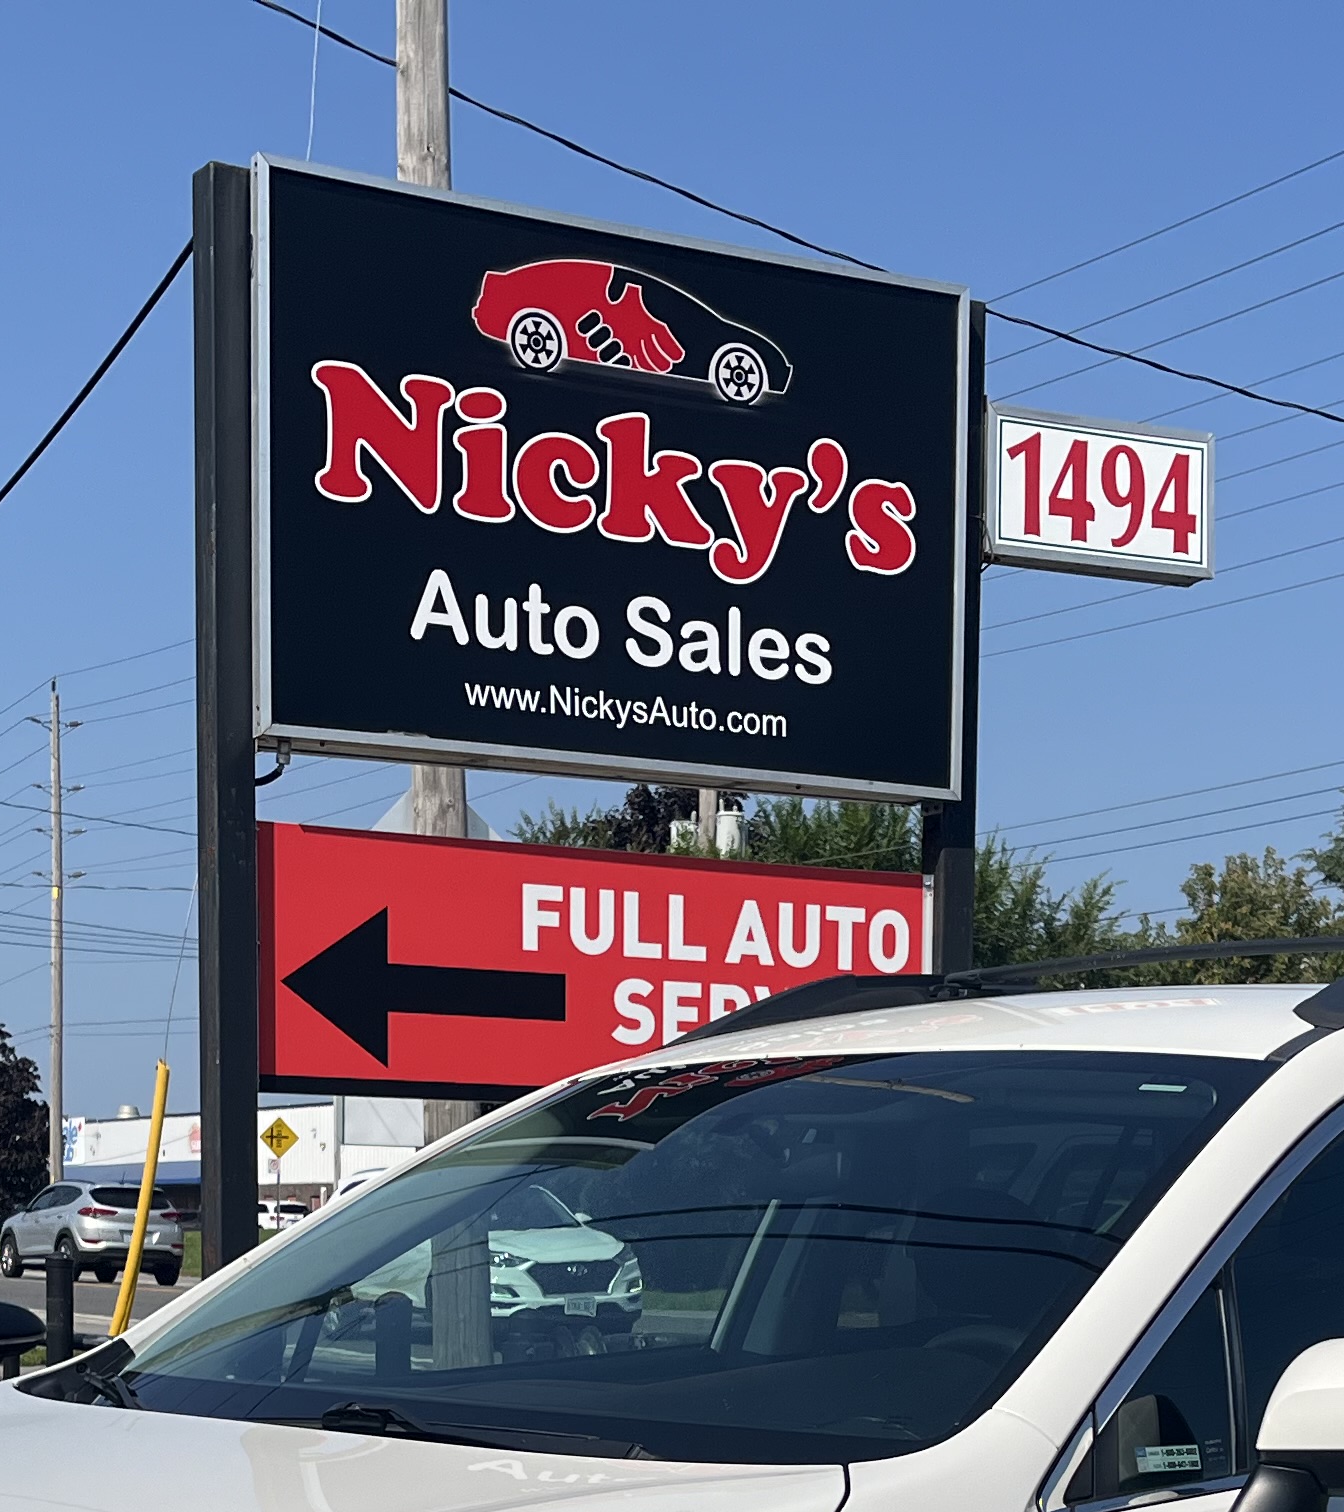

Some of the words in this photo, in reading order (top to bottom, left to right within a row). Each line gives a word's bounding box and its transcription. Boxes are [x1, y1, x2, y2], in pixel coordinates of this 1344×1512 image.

[311, 360, 917, 585] Nicky's
[1006, 432, 1197, 554] 1494
[409, 567, 600, 661] Auto
[625, 594, 834, 686] Sales
[464, 681, 788, 738] www.NickysAuto.com
[521, 882, 707, 962] FULL
[724, 899, 910, 975] AUTO
